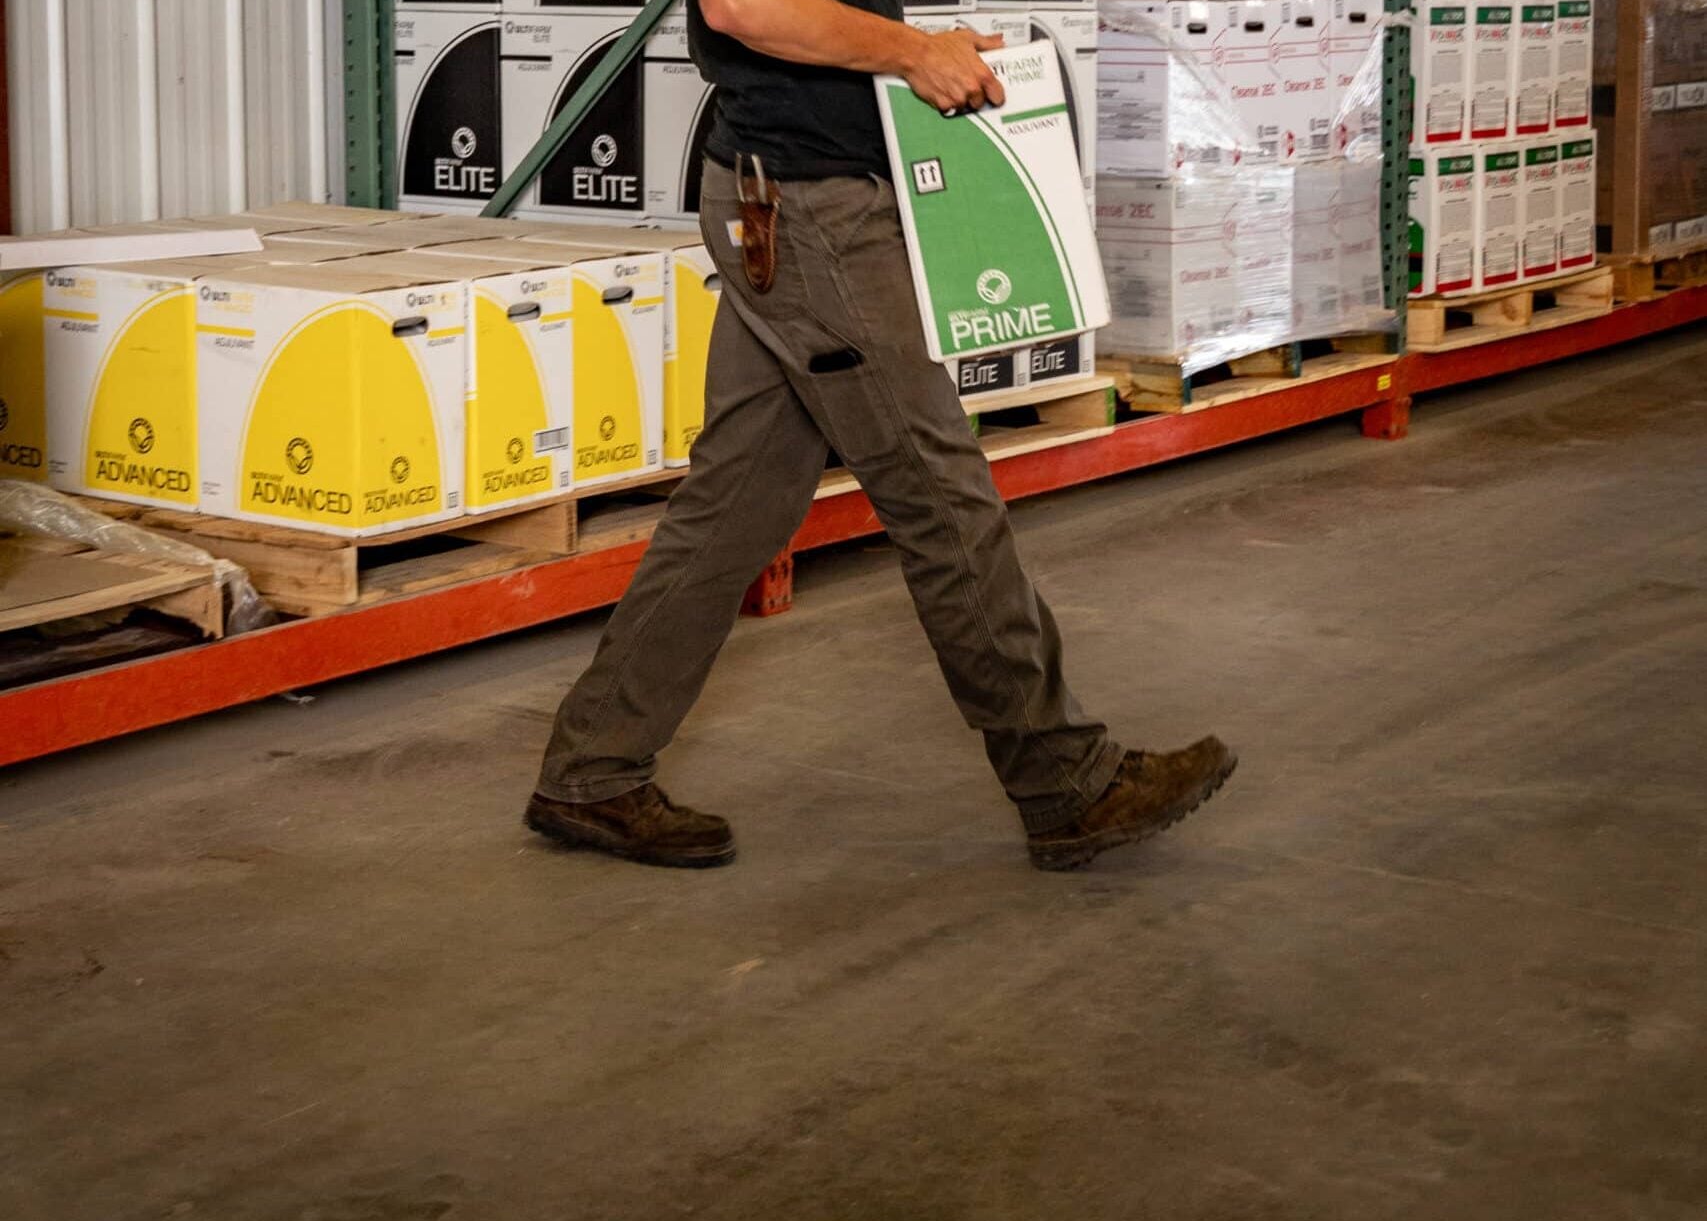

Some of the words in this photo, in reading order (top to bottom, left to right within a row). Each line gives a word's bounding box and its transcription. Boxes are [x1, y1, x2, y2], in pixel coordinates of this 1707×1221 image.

[1007, 116, 1060, 137] ADJUVANT
[435, 165, 497, 194] ELITE
[573, 173, 638, 203] ELITE
[950, 302, 1055, 351] PRIME
[960, 361, 999, 389] ELITE
[1032, 350, 1066, 376] ELITE
[0, 442, 42, 469] NCED
[577, 442, 639, 470] ADVANCED
[95, 458, 192, 494] ADVANCED
[483, 465, 549, 494] ADVANCED
[251, 480, 353, 516] ADVANCED
[363, 484, 437, 514] ADVANCED
